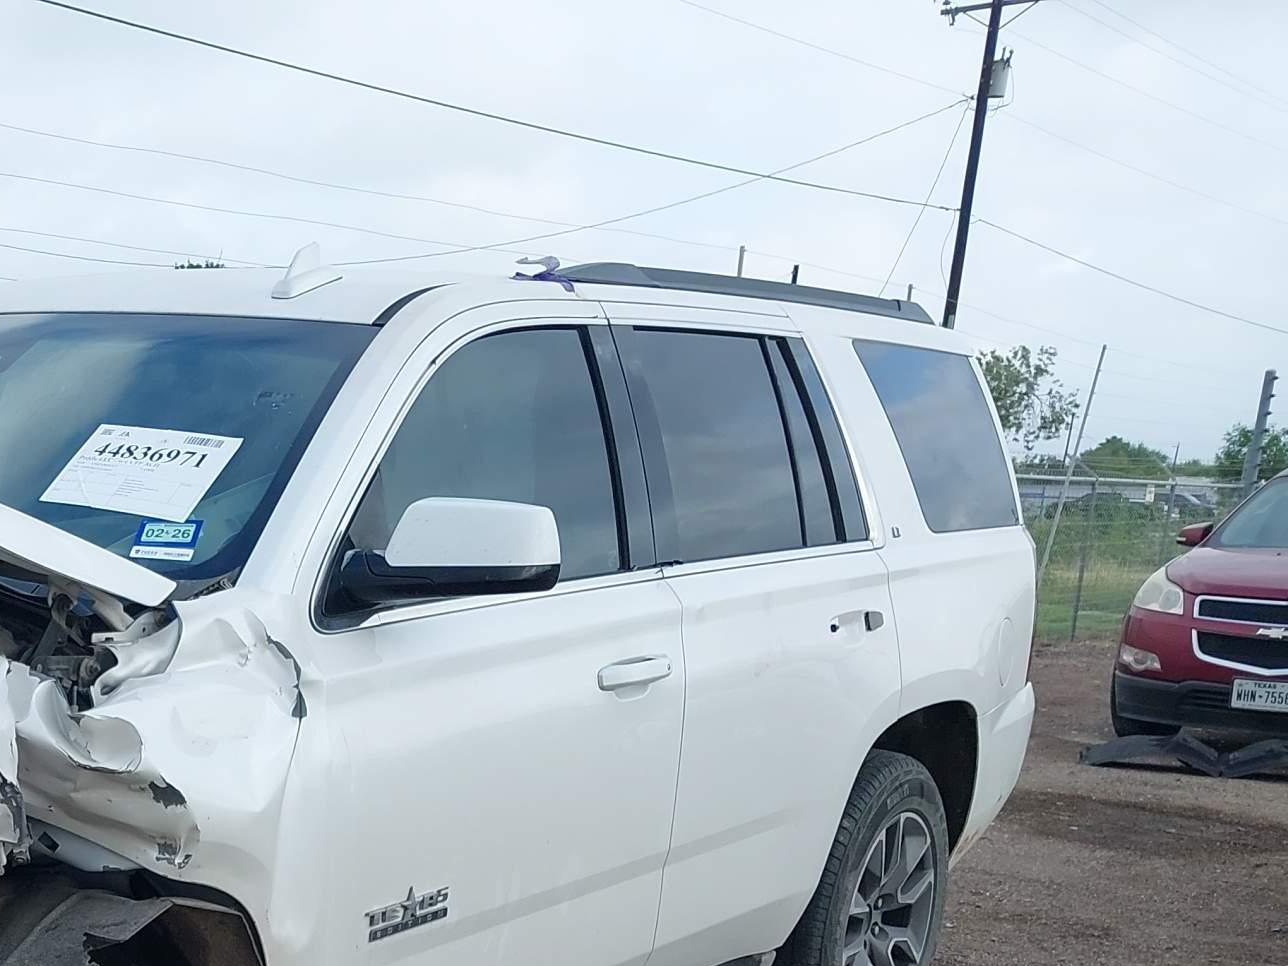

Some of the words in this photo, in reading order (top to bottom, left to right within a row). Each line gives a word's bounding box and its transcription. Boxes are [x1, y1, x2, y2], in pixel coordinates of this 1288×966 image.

[94, 442, 209, 468] 44836971
[145, 528, 164, 538] 02
[171, 528, 191, 538] 26
[364, 886, 449, 927] TEXAS
[373, 908, 448, 939] EDITION
